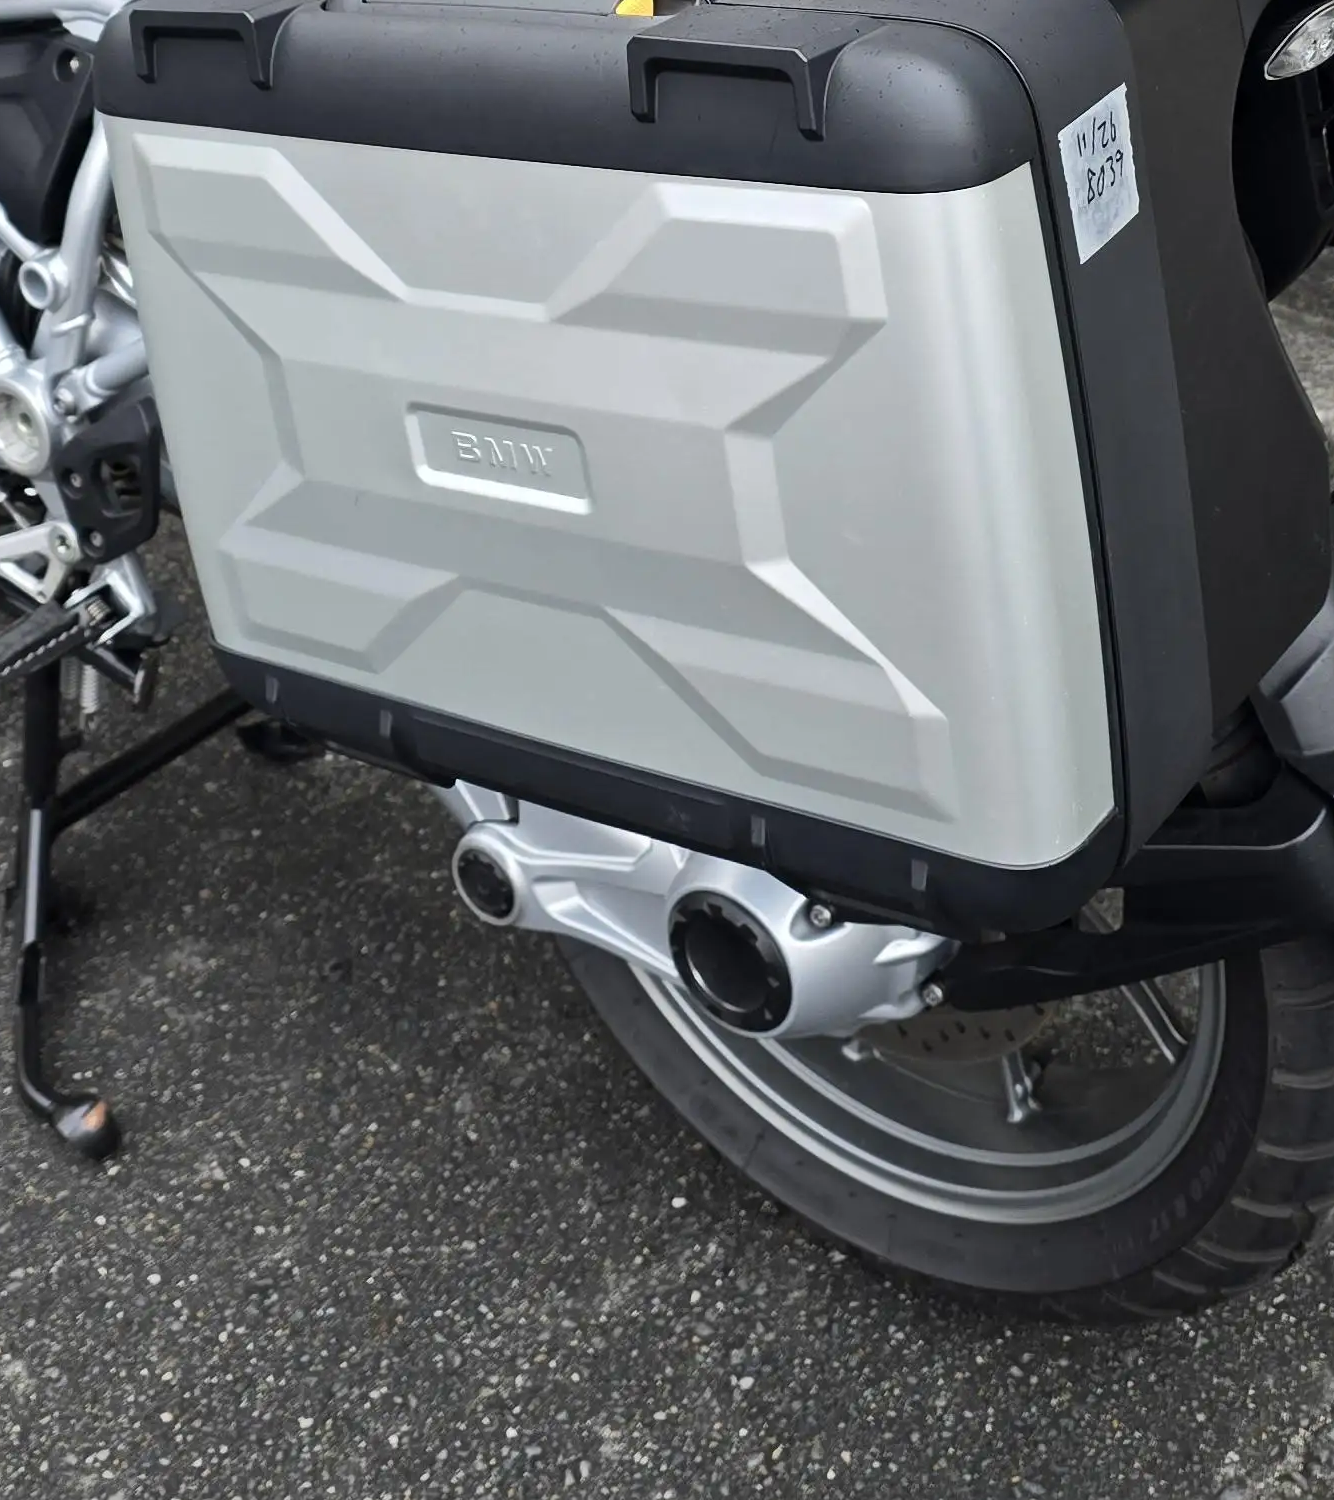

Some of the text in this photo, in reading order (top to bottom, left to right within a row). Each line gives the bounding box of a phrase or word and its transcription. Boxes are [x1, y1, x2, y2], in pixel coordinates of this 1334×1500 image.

[1077, 111, 1117, 157] 11/26
[1087, 149, 1124, 205] 8039
[450, 430, 554, 478] BMW
